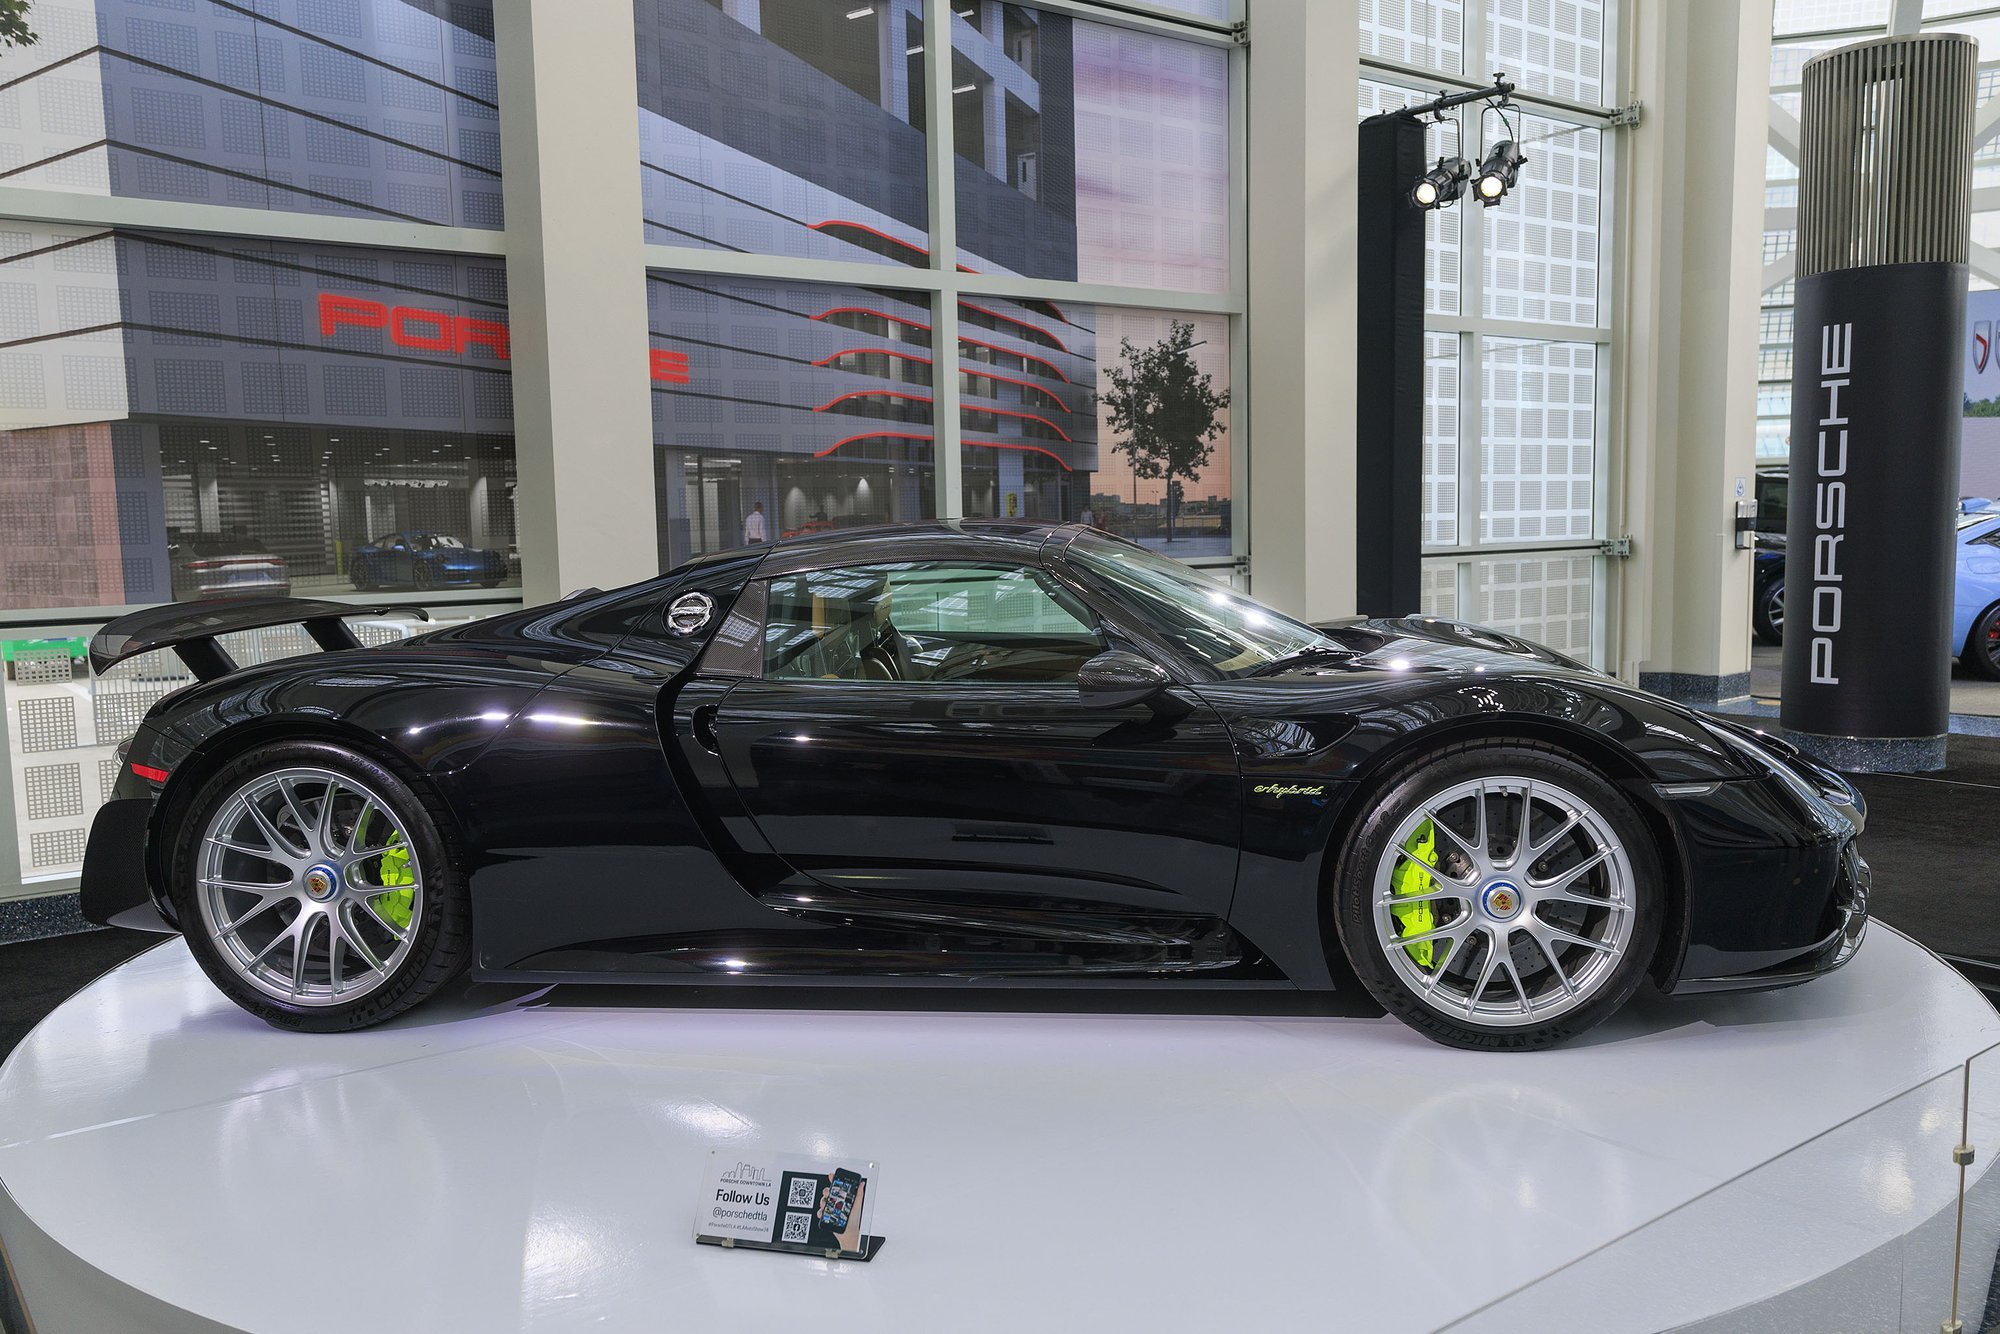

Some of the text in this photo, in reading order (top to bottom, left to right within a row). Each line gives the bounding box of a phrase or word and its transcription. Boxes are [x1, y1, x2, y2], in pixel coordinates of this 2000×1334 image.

[318, 293, 690, 385] PORE
[1810, 322, 1852, 685] PORSCHE
[1351, 846, 1371, 889] Sport
[1351, 888, 1362, 926] Pilot
[376, 927, 441, 1009] MICHELIN
[1408, 1007, 1504, 1047] MICHELIN
[712, 1206, 768, 1221] @porschedtla
[715, 1188, 770, 1206] Follow Us
